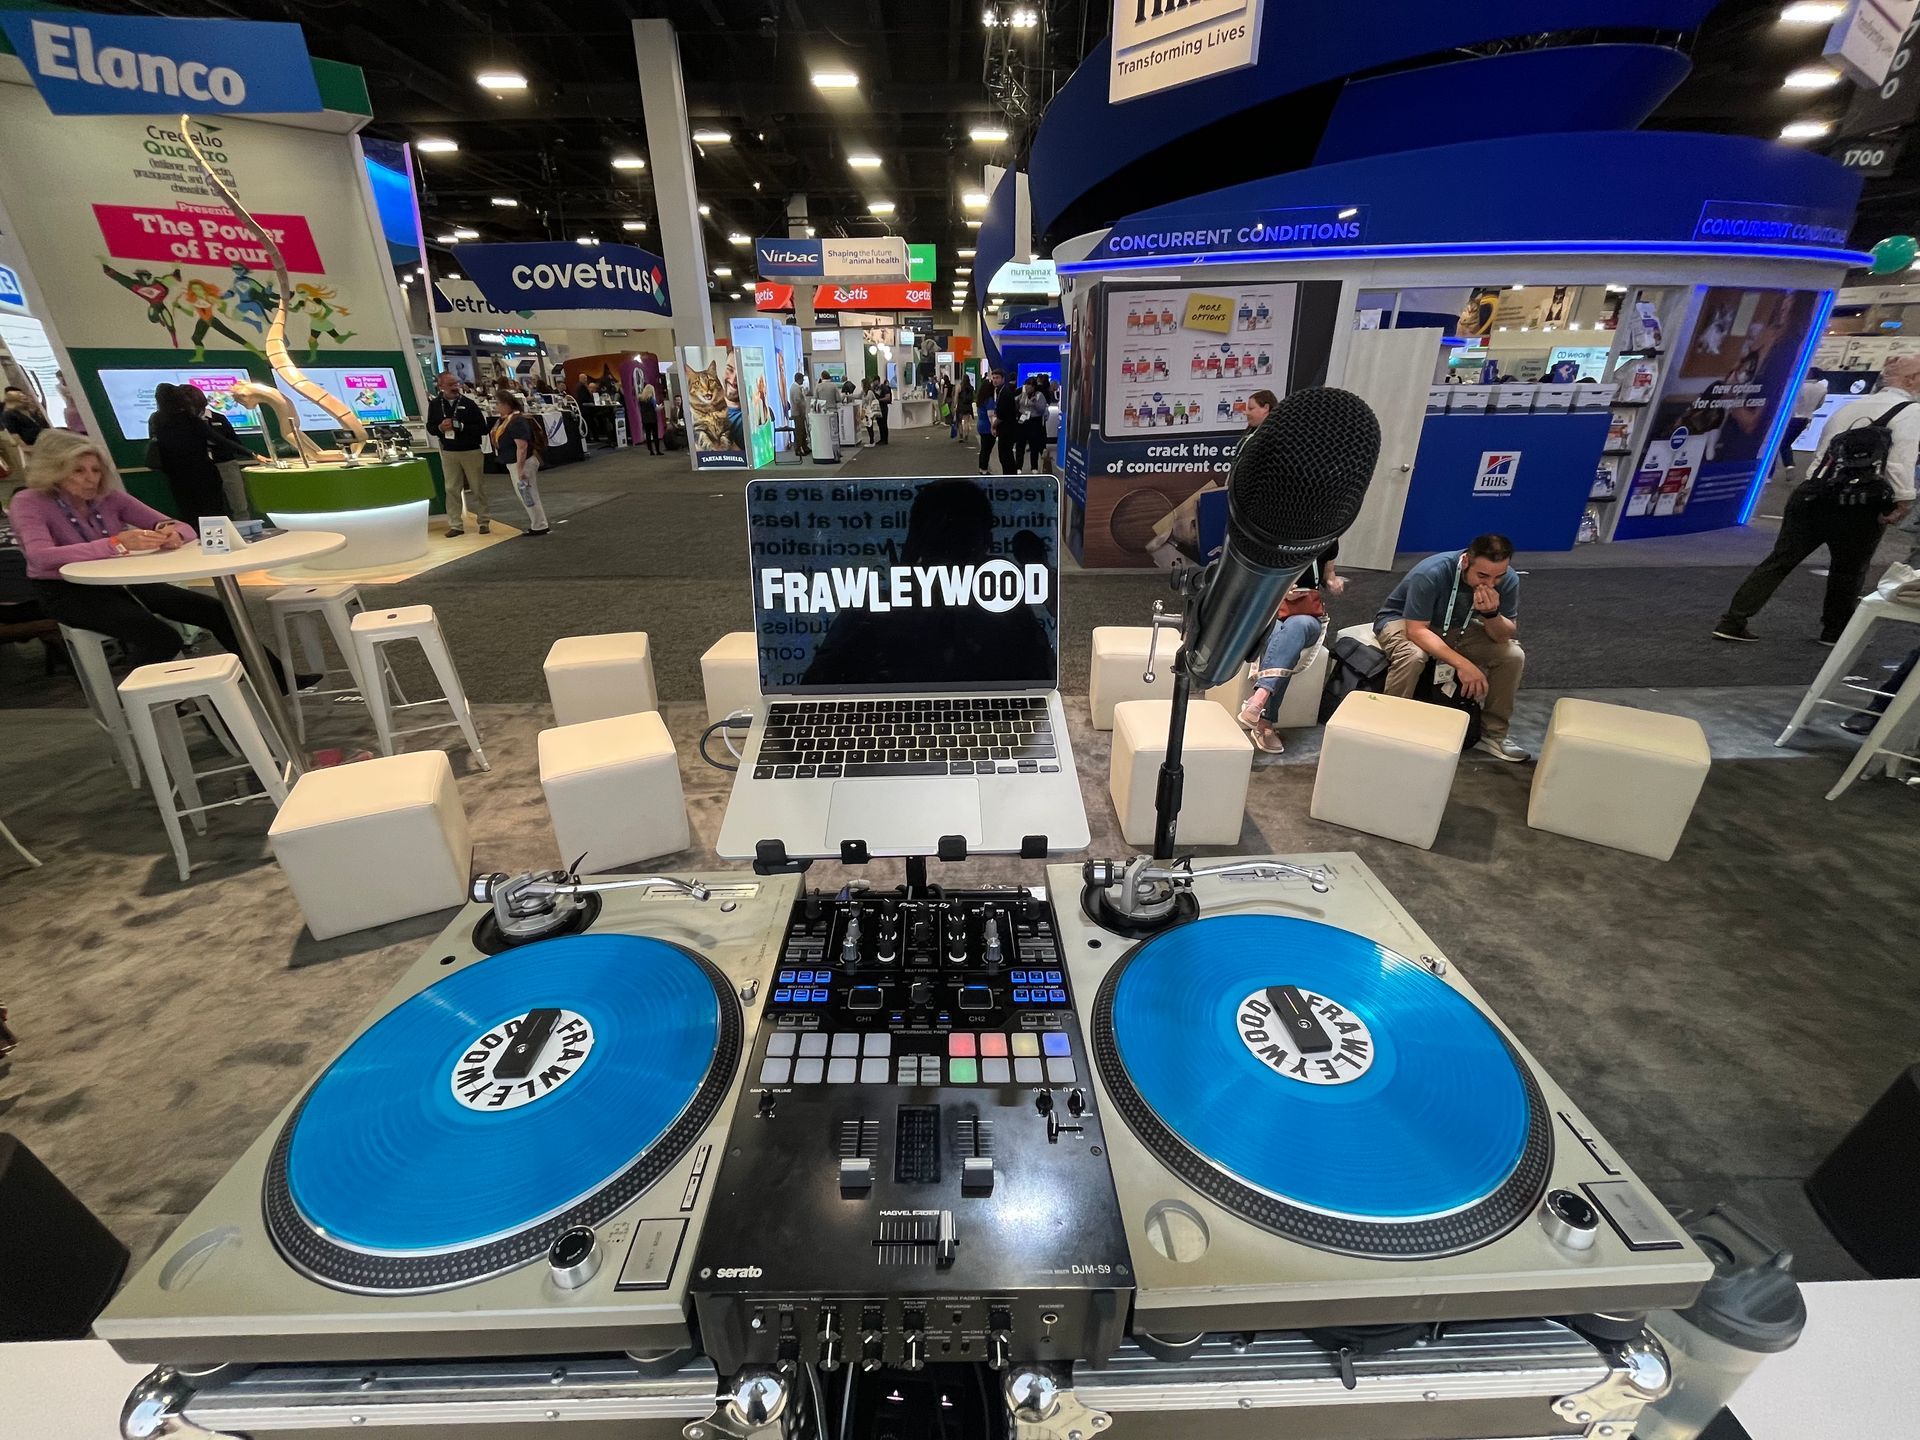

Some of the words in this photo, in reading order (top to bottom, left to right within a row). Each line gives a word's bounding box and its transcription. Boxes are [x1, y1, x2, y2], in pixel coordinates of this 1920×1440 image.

[1117, 39, 1203, 76] Transforming
[1207, 25, 1245, 48] Lives
[31, 18, 246, 106] Elanco
[143, 140, 229, 164] Quatro
[1842, 150, 1884, 167] 1700
[133, 213, 195, 238] The
[1700, 218, 1791, 239] CONCURRENT
[1109, 228, 1232, 253] CONCURRENT
[1236, 222, 1360, 242] CONDITIONS
[171, 239, 202, 259] of
[205, 241, 270, 264] Four
[760, 249, 819, 264] Virbac
[828, 250, 859, 258] Shaping
[848, 256, 875, 264] animal
[876, 256, 900, 264] health
[512, 256, 652, 294] covetrus
[1197, 303, 1222, 311] MORE
[1191, 313, 1226, 321] OPTIONS
[1711, 384, 1731, 394] new
[1693, 398, 1708, 410] for
[1147, 444, 1189, 457] crack
[1192, 444, 1218, 457] the
[1221, 446, 1237, 457] ca
[1106, 460, 1123, 473] of
[1126, 460, 1210, 473] concurrent
[1213, 463, 1231, 473] co
[1480, 476, 1508, 487] Hill's
[761, 559, 1048, 613] FRAWLEYWOOD
[716, 1265, 763, 1279] serato
[1071, 1264, 1111, 1274] DJM-S9
